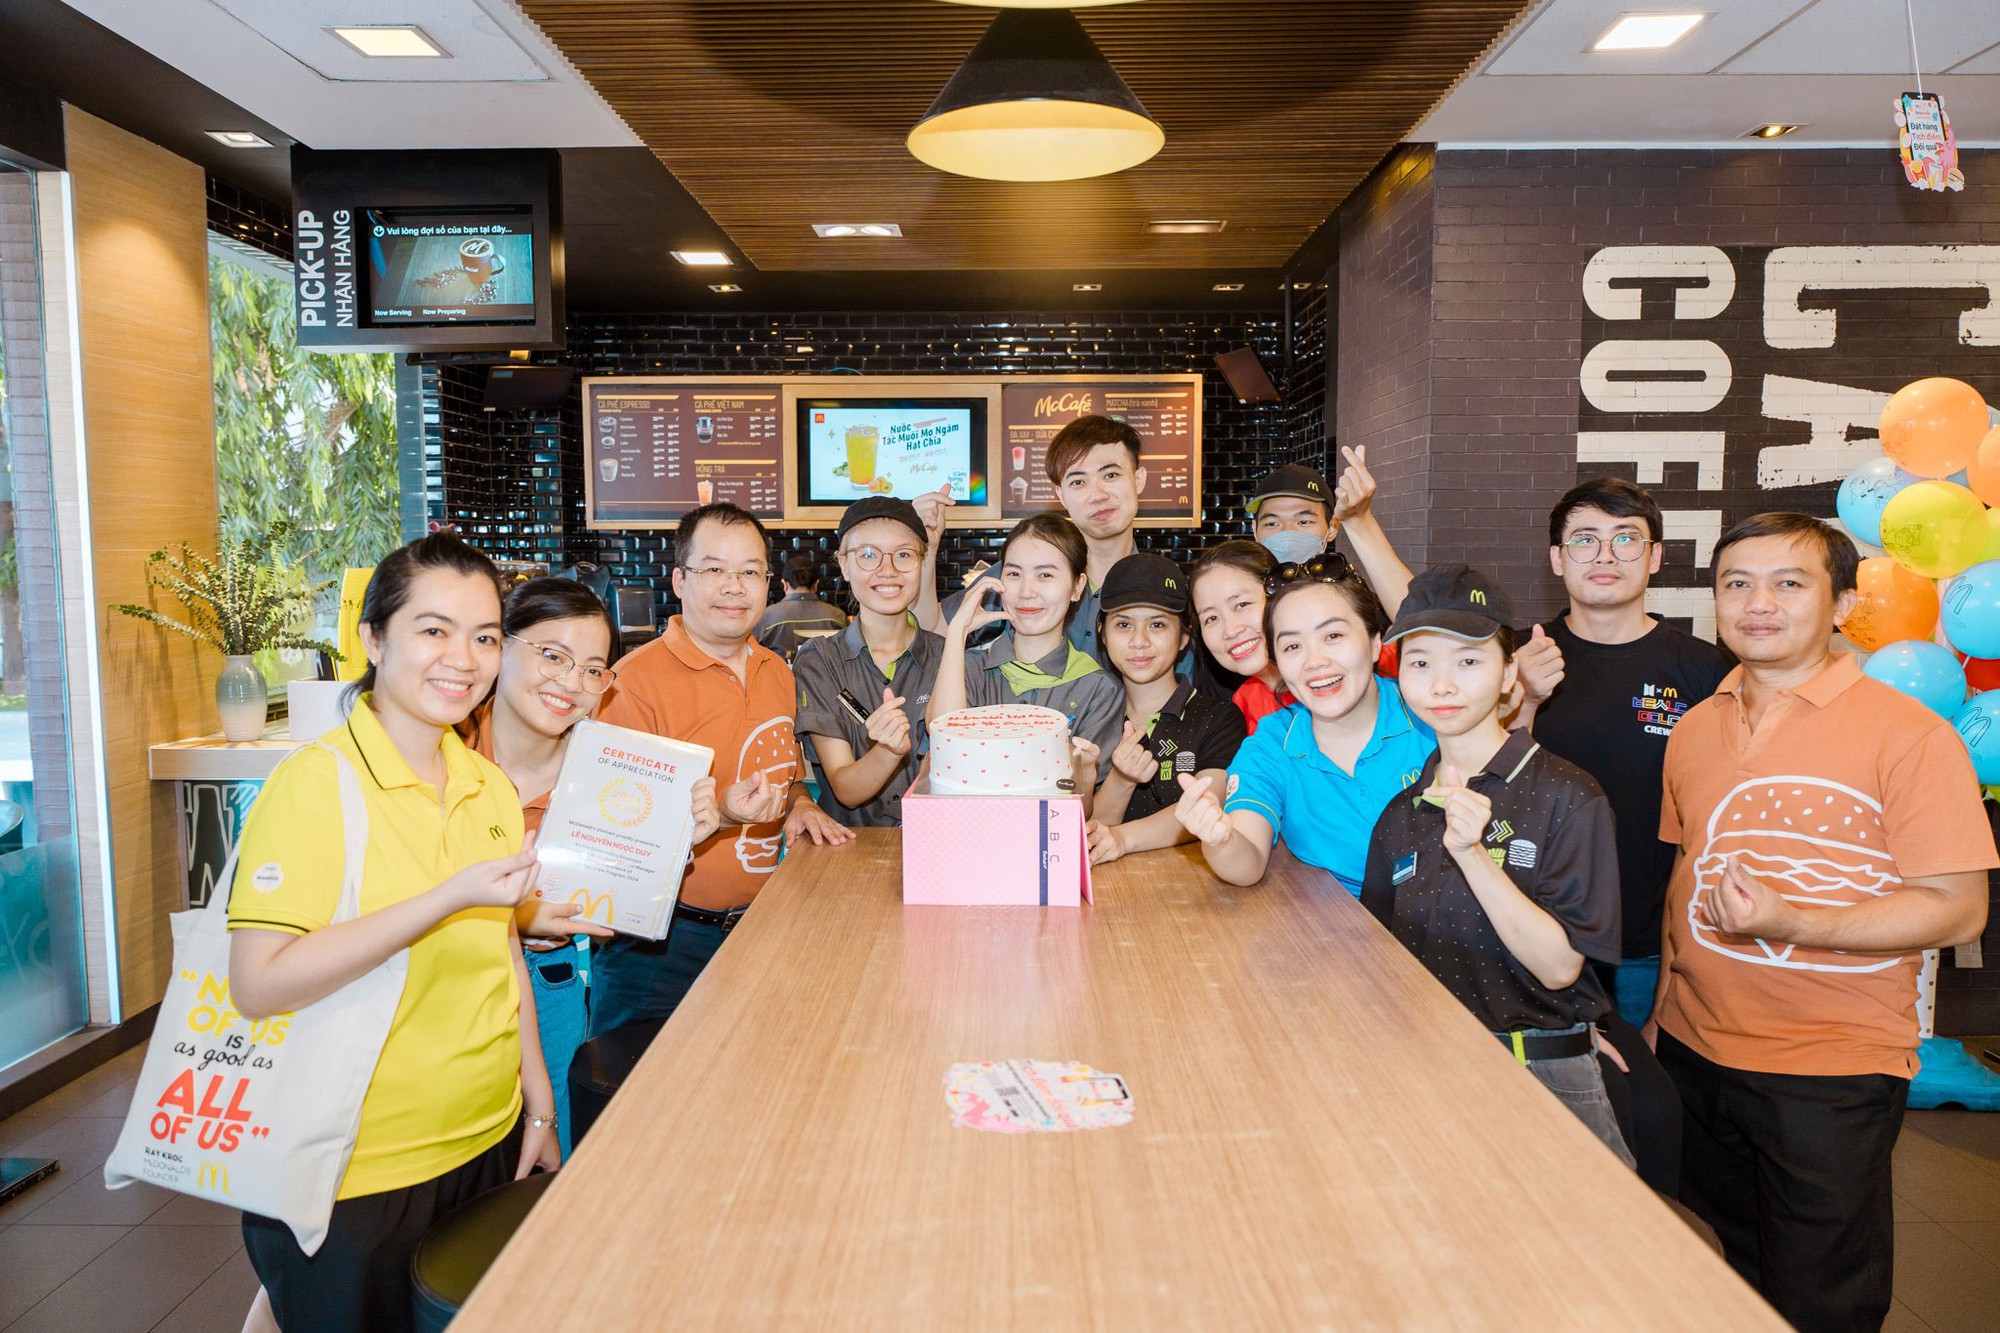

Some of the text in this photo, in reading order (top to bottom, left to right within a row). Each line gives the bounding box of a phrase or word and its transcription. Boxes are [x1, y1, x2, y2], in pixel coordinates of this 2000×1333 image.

[386, 227, 400, 235] Vui
[401, 227, 419, 236] lòng
[420, 227, 434, 237] đợi
[447, 225, 462, 234] của
[463, 226, 479, 236] bạn
[480, 225, 490, 235] tại
[298, 210, 326, 327] PICK-UP
[330, 209, 356, 327] NHẬN HÀNG
[389, 309, 412, 317] Serving
[437, 308, 466, 316] Preparing
[620, 400, 651, 409] ESPRESSO
[731, 401, 745, 409] NAM
[1034, 393, 1093, 418] McCafé
[923, 436, 942, 448] Chia
[1644, 725, 1673, 737] CREW
[602, 746, 677, 775] CERTIFICATE
[598, 756, 674, 784] OF APPRECIATION
[634, 847, 653, 858] DUY
[187, 1005, 291, 1047] OF US
[225, 1034, 245, 1049] IS
[174, 1041, 273, 1071] as good as
[157, 1068, 252, 1123] ALL
[150, 1111, 194, 1144] OF
[145, 1146, 184, 1164] RAY KROC
